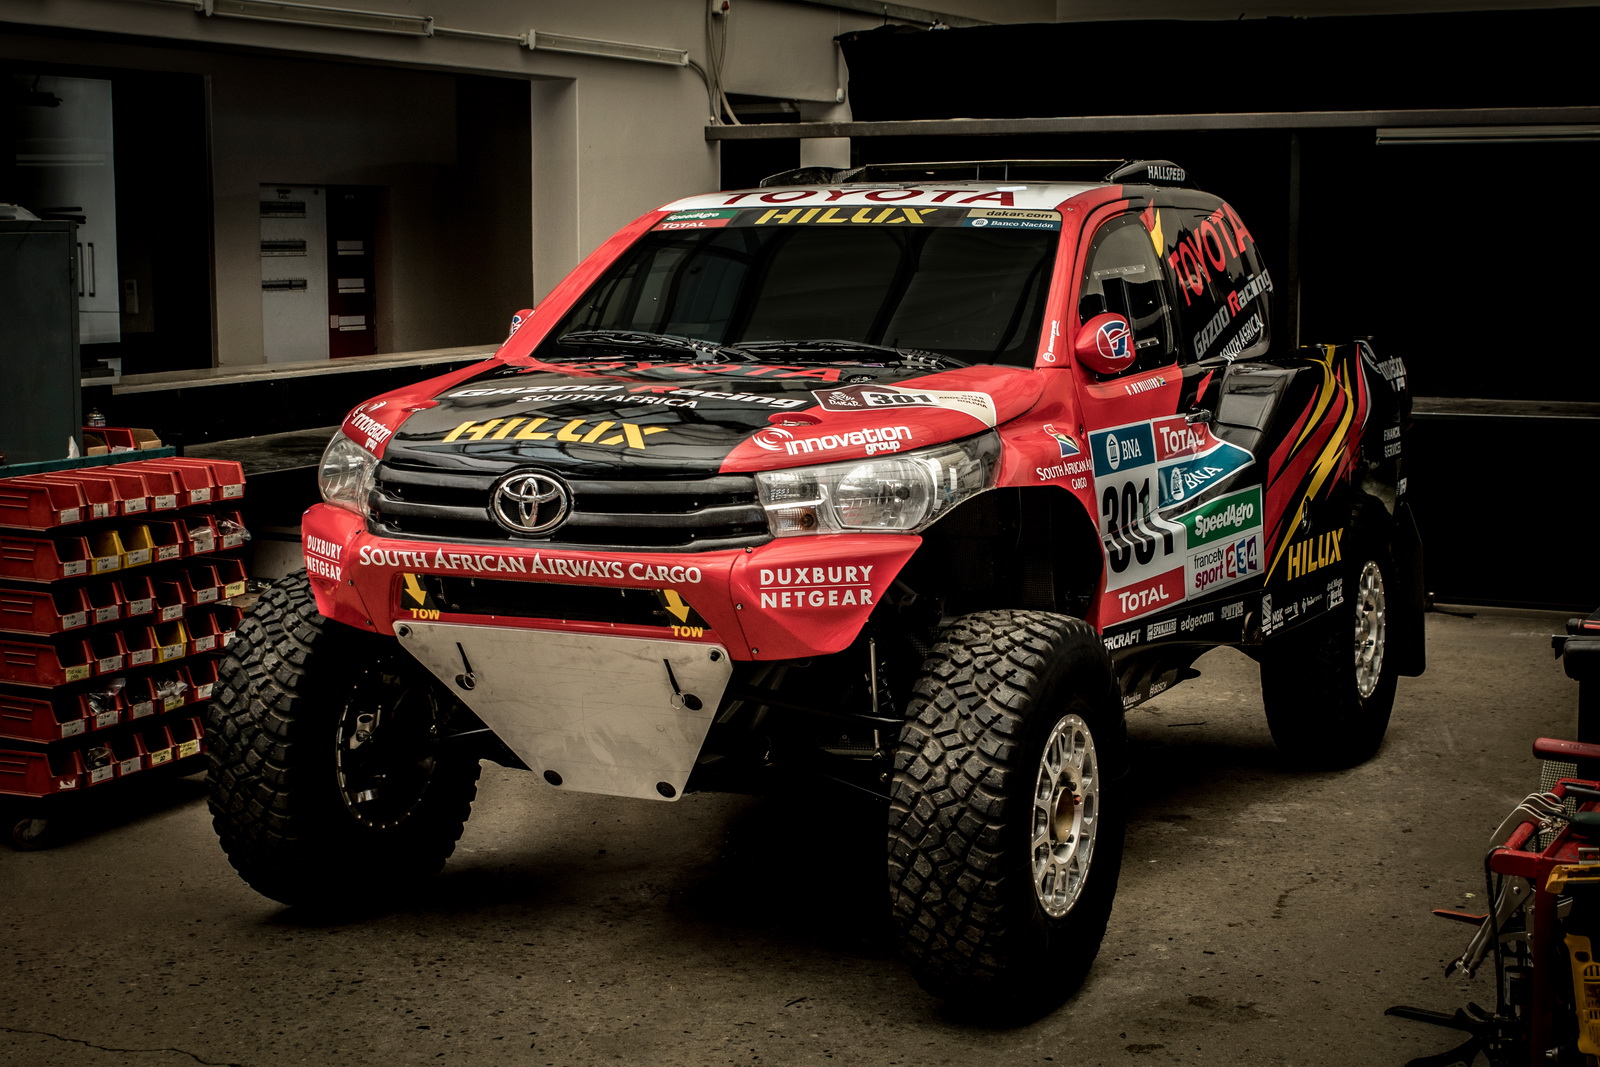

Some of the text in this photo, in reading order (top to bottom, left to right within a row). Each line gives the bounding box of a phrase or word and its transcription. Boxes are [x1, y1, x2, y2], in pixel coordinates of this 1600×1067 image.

[1147, 165, 1186, 182] HALLSPEED
[722, 189, 1015, 207] TOYOTA
[662, 222, 707, 230] TOTAL
[754, 208, 939, 225] HILUX
[986, 210, 1053, 219] dakar.com
[1167, 202, 1255, 307] TOYOTA
[1193, 268, 1274, 361] GAZOO Racing
[1220, 312, 1265, 366] SOUTH AFRICA
[449, 385, 808, 408] GAZOO Racing
[516, 394, 699, 410] SOUTH AFRICA
[828, 398, 863, 407] DAKAR
[867, 393, 932, 406] 301
[350, 412, 393, 444] innovation
[442, 417, 669, 450] HILUX
[1159, 426, 1206, 452] TOTAL
[785, 425, 912, 455] innovation
[864, 440, 901, 455] group
[1120, 437, 1143, 461] BNA
[1036, 465, 1065, 481] SOUTH
[1062, 460, 1087, 475] AFRICAN
[1182, 465, 1224, 490] BNA
[1071, 476, 1088, 490] CARGO
[1102, 477, 1174, 573] 301
[1194, 502, 1254, 539] SpeedAgro
[306, 534, 343, 561] DUXBURY
[1194, 548, 1224, 569] francetv
[1286, 528, 1345, 582] HILUX
[306, 555, 342, 582] NETGEAR
[359, 545, 702, 584] SOUTH AFRICAN AIRWAYS CARGO
[759, 565, 873, 586] DUXBURY
[1195, 561, 1224, 590] sport
[759, 589, 873, 609] NETGEAR
[1118, 583, 1170, 614] TOTAL
[410, 607, 440, 620] TOW
[1180, 612, 1215, 632] edgecam
[671, 625, 703, 638] TOW
